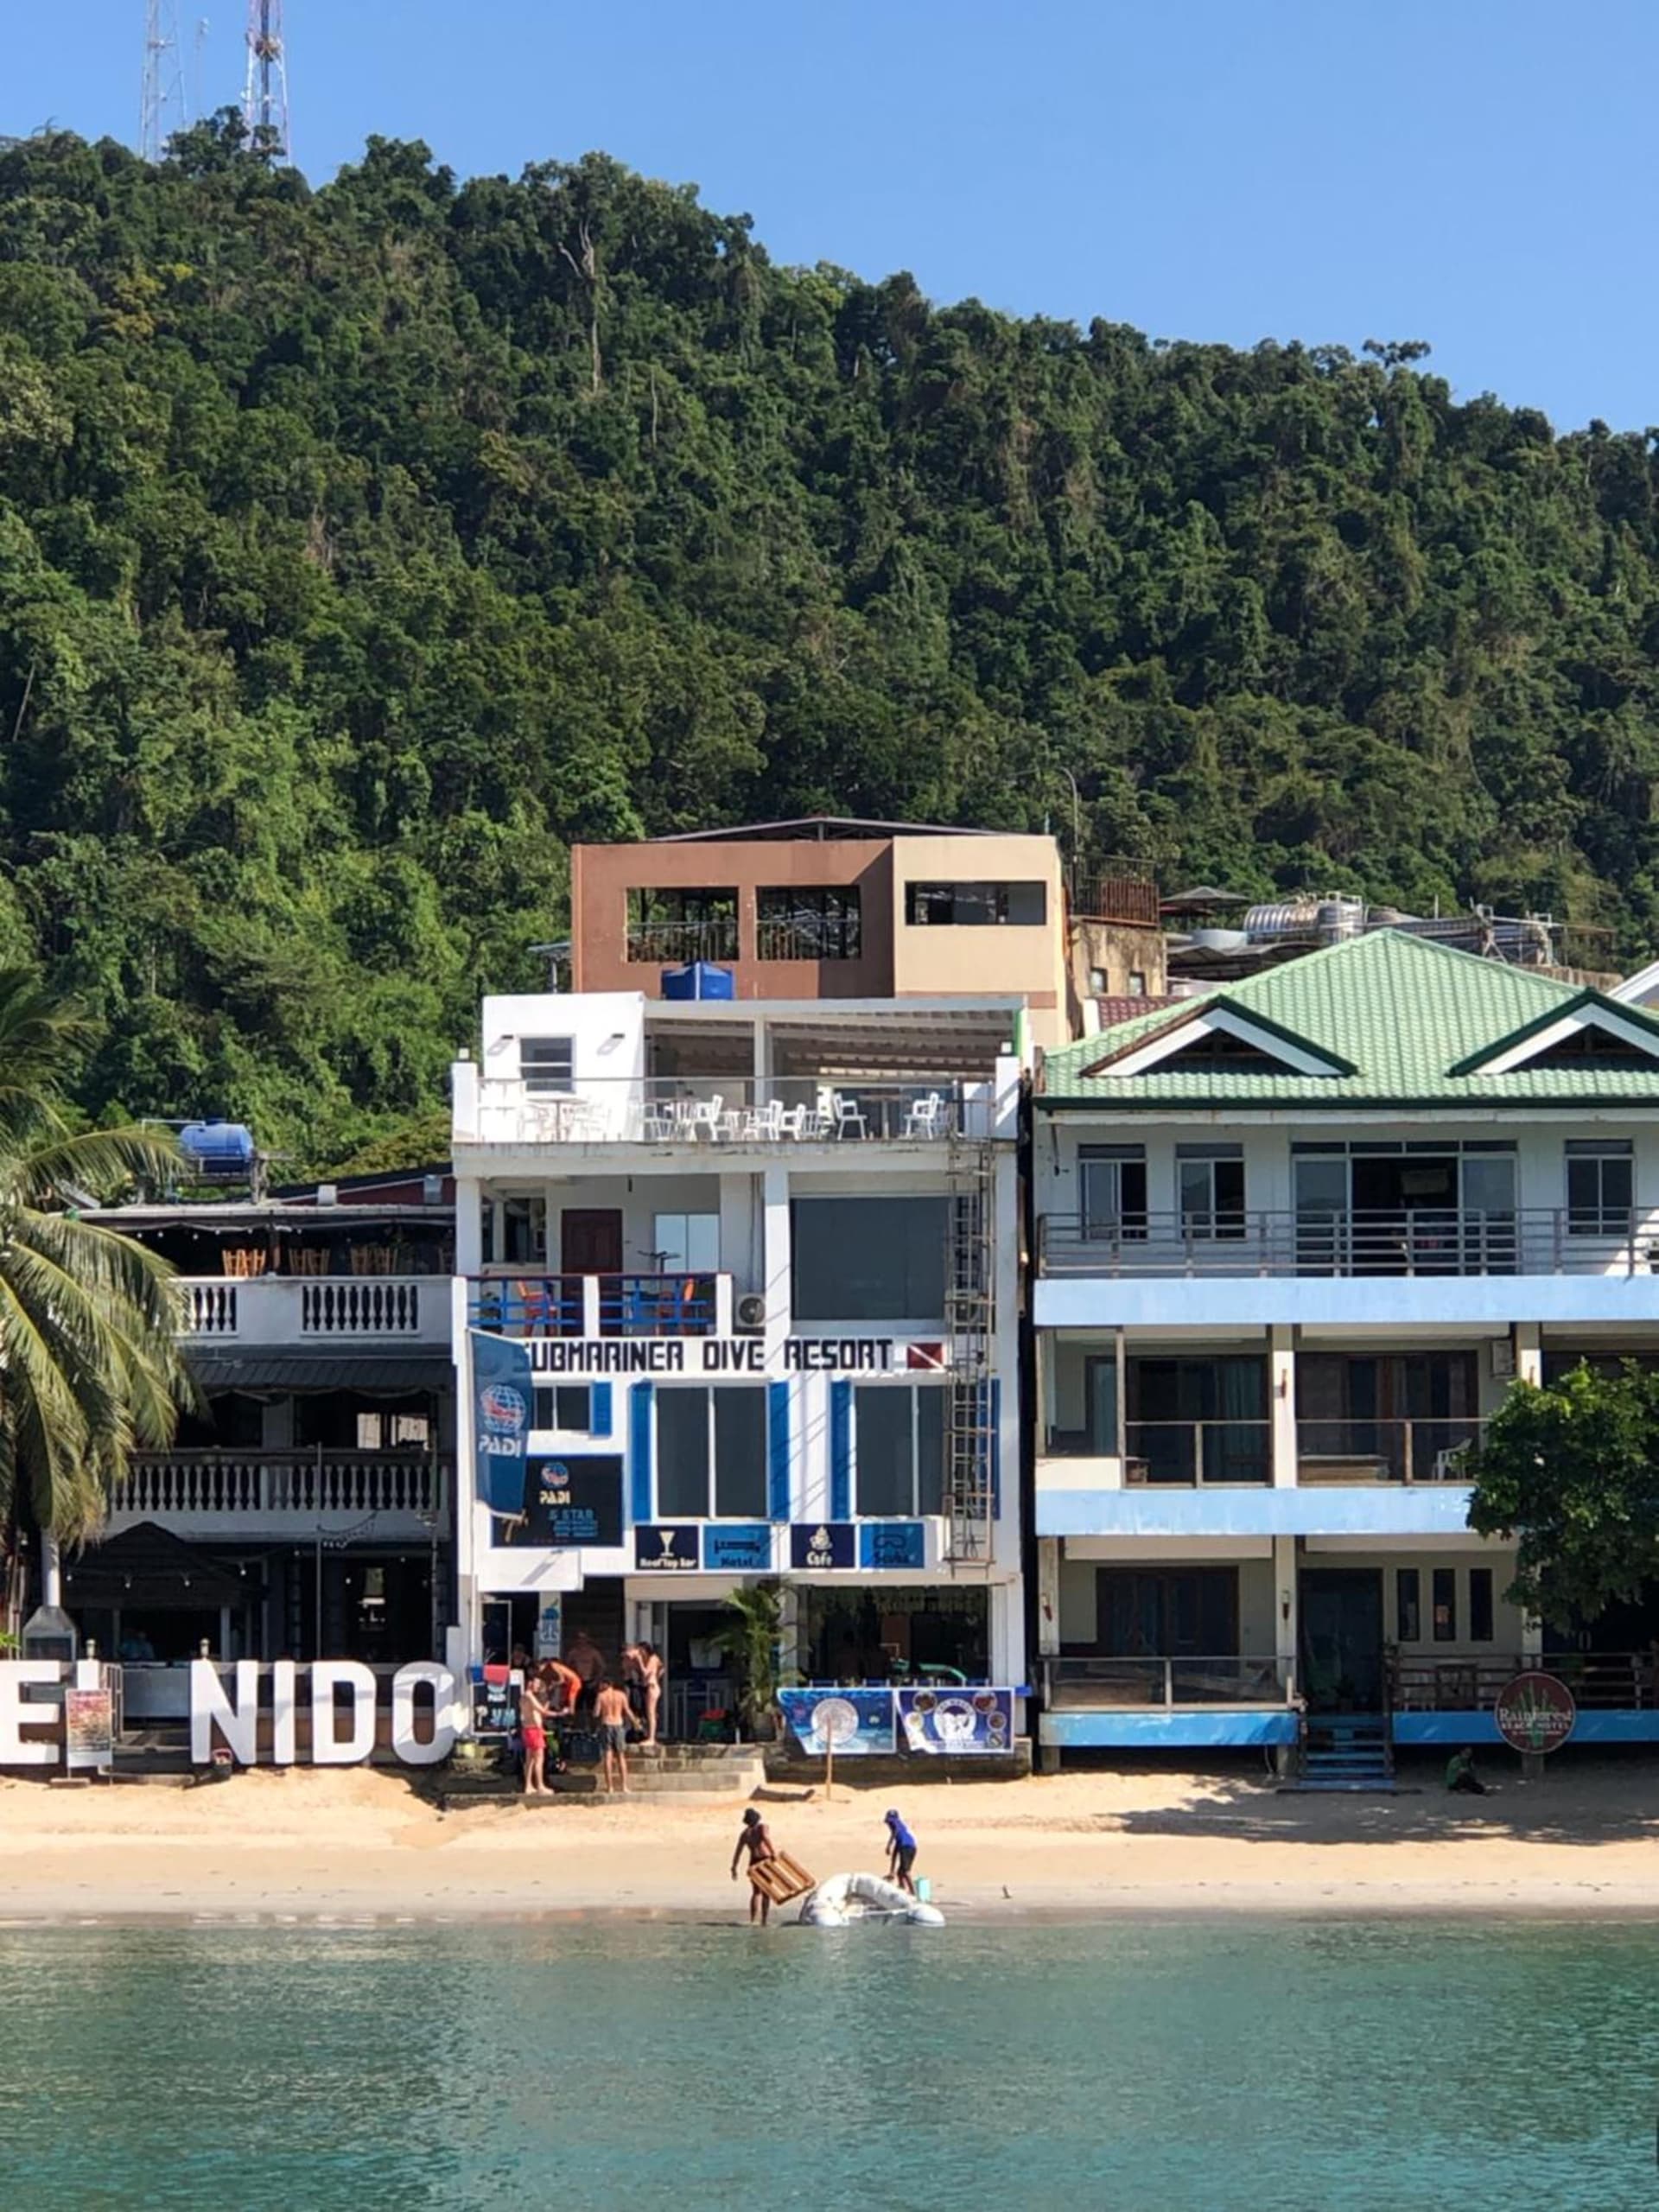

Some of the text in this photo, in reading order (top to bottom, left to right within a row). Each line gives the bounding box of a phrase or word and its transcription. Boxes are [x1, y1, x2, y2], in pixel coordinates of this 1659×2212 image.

[524, 1338, 893, 1372] UBMARINER DIVE RESORT
[478, 1434, 521, 1459] PADI
[539, 1490, 571, 1504] PADI
[562, 1509, 594, 1521] STAR
[190, 1660, 457, 1764] NIDO
[1498, 1707, 1572, 1722] Rainforest
